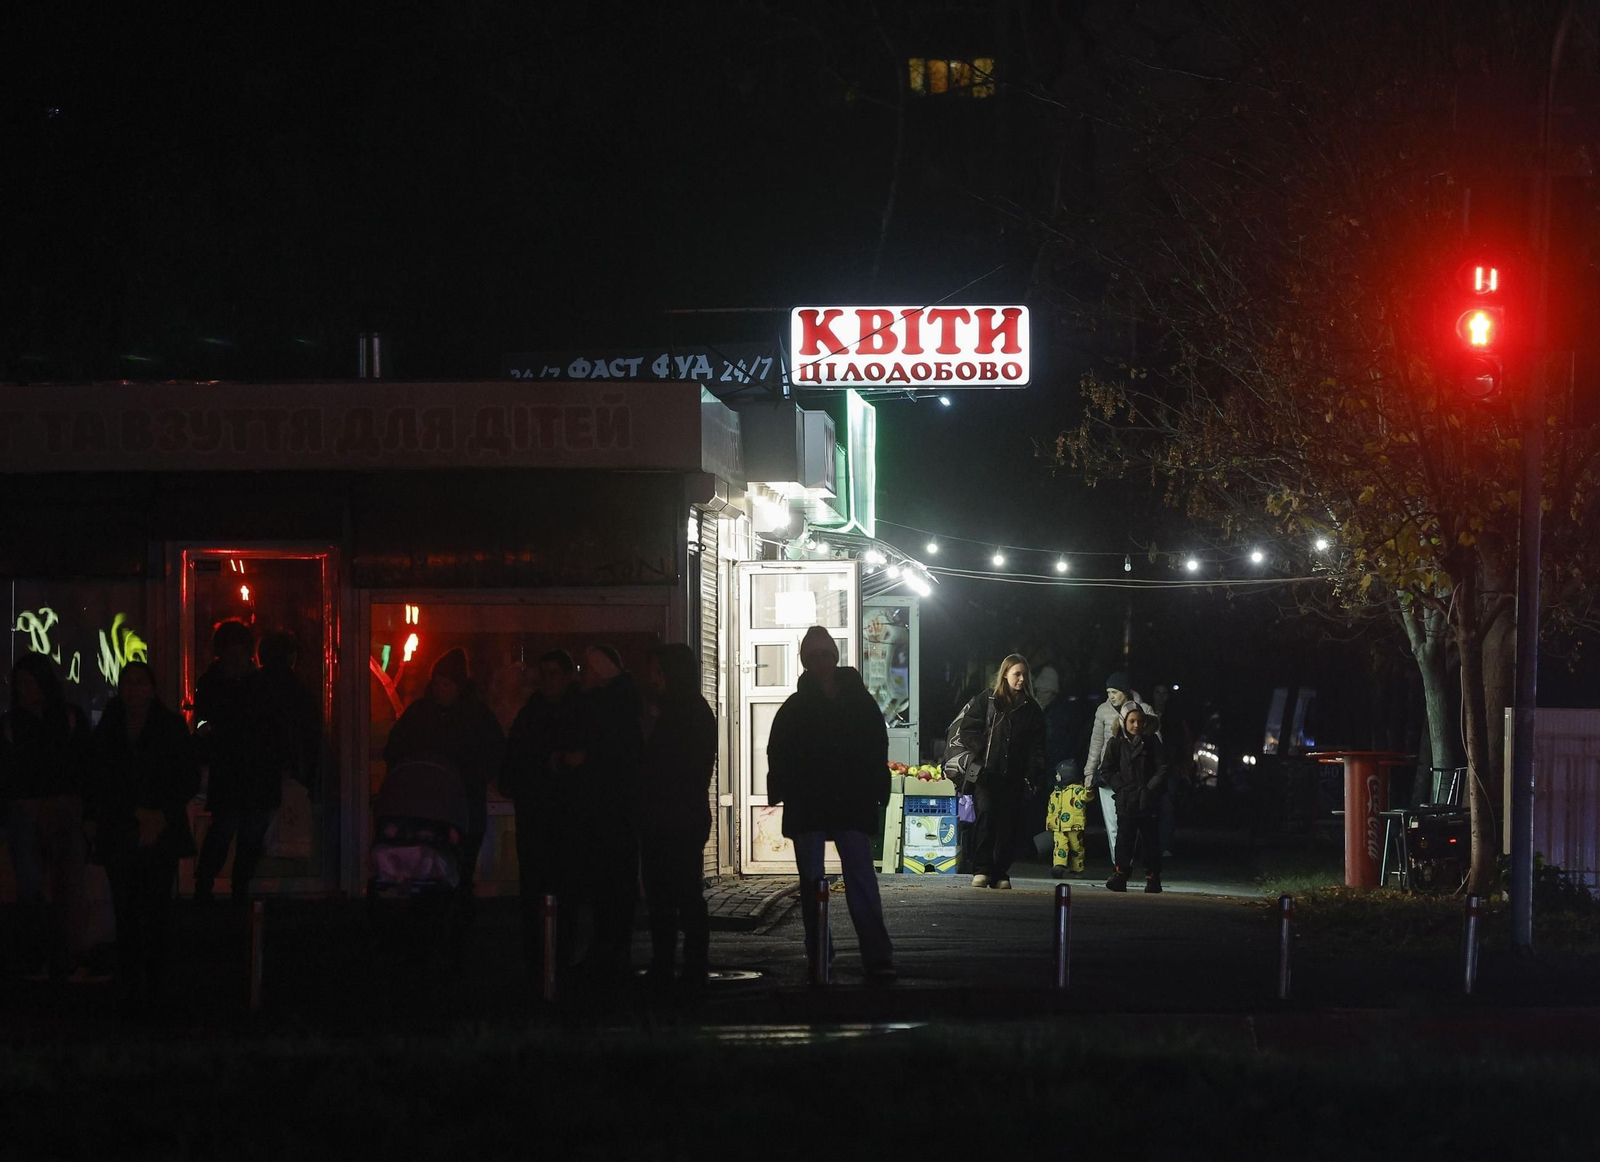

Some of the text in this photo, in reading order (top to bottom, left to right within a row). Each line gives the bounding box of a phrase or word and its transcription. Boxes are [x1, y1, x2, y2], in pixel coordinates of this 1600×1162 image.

[798, 308, 1023, 356] КВІТИ
[568, 357, 645, 379] ФАСТ
[719, 355, 774, 384] 24/7
[798, 361, 1023, 384] ЦІЛОДОБОВО
[36, 409, 106, 451] ТА
[115, 408, 325, 451] ВЗУТТЯ
[334, 405, 455, 455] ДЛЯ
[467, 393, 632, 454] ДІТЕЙ
